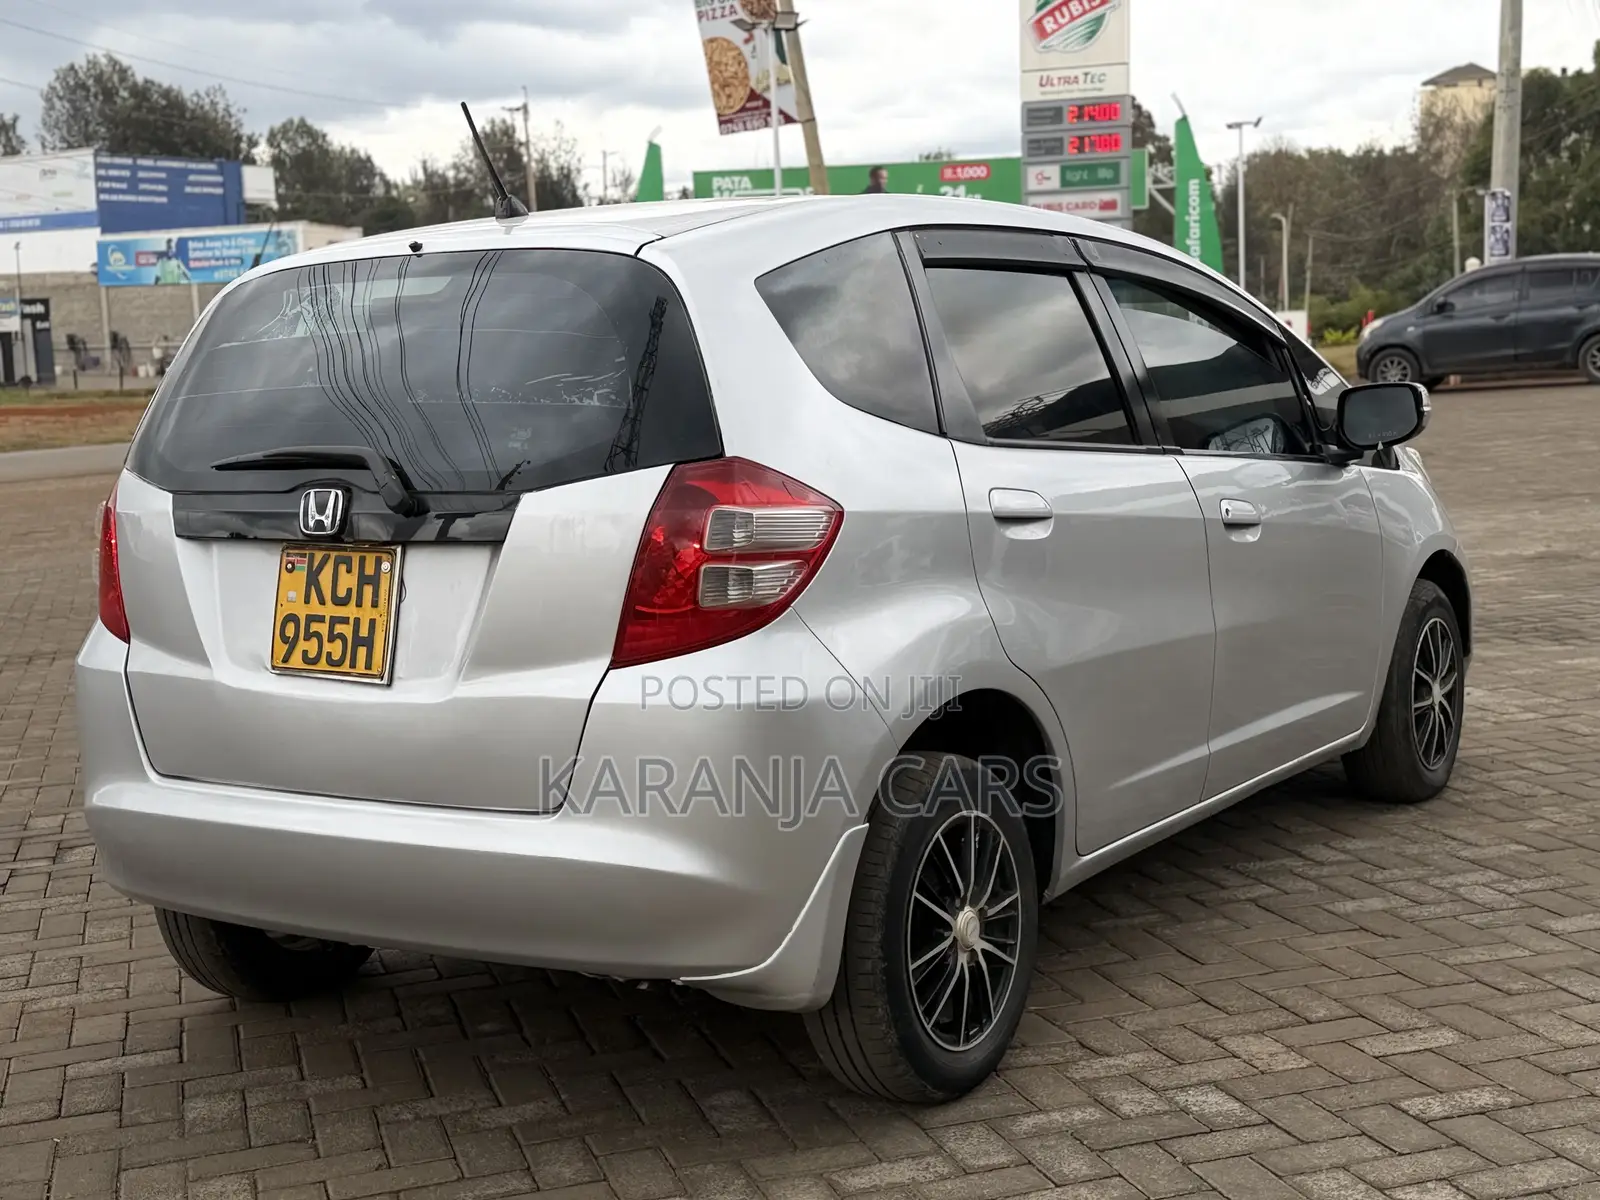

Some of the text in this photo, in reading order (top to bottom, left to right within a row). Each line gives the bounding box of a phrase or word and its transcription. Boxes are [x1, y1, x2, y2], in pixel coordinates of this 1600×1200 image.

[697, 4, 738, 21] PIZZA
[1038, 72, 1107, 88] ULTRA TEC
[712, 175, 752, 190] PATA
[304, 552, 382, 609] KCH
[279, 612, 376, 671] 955H
